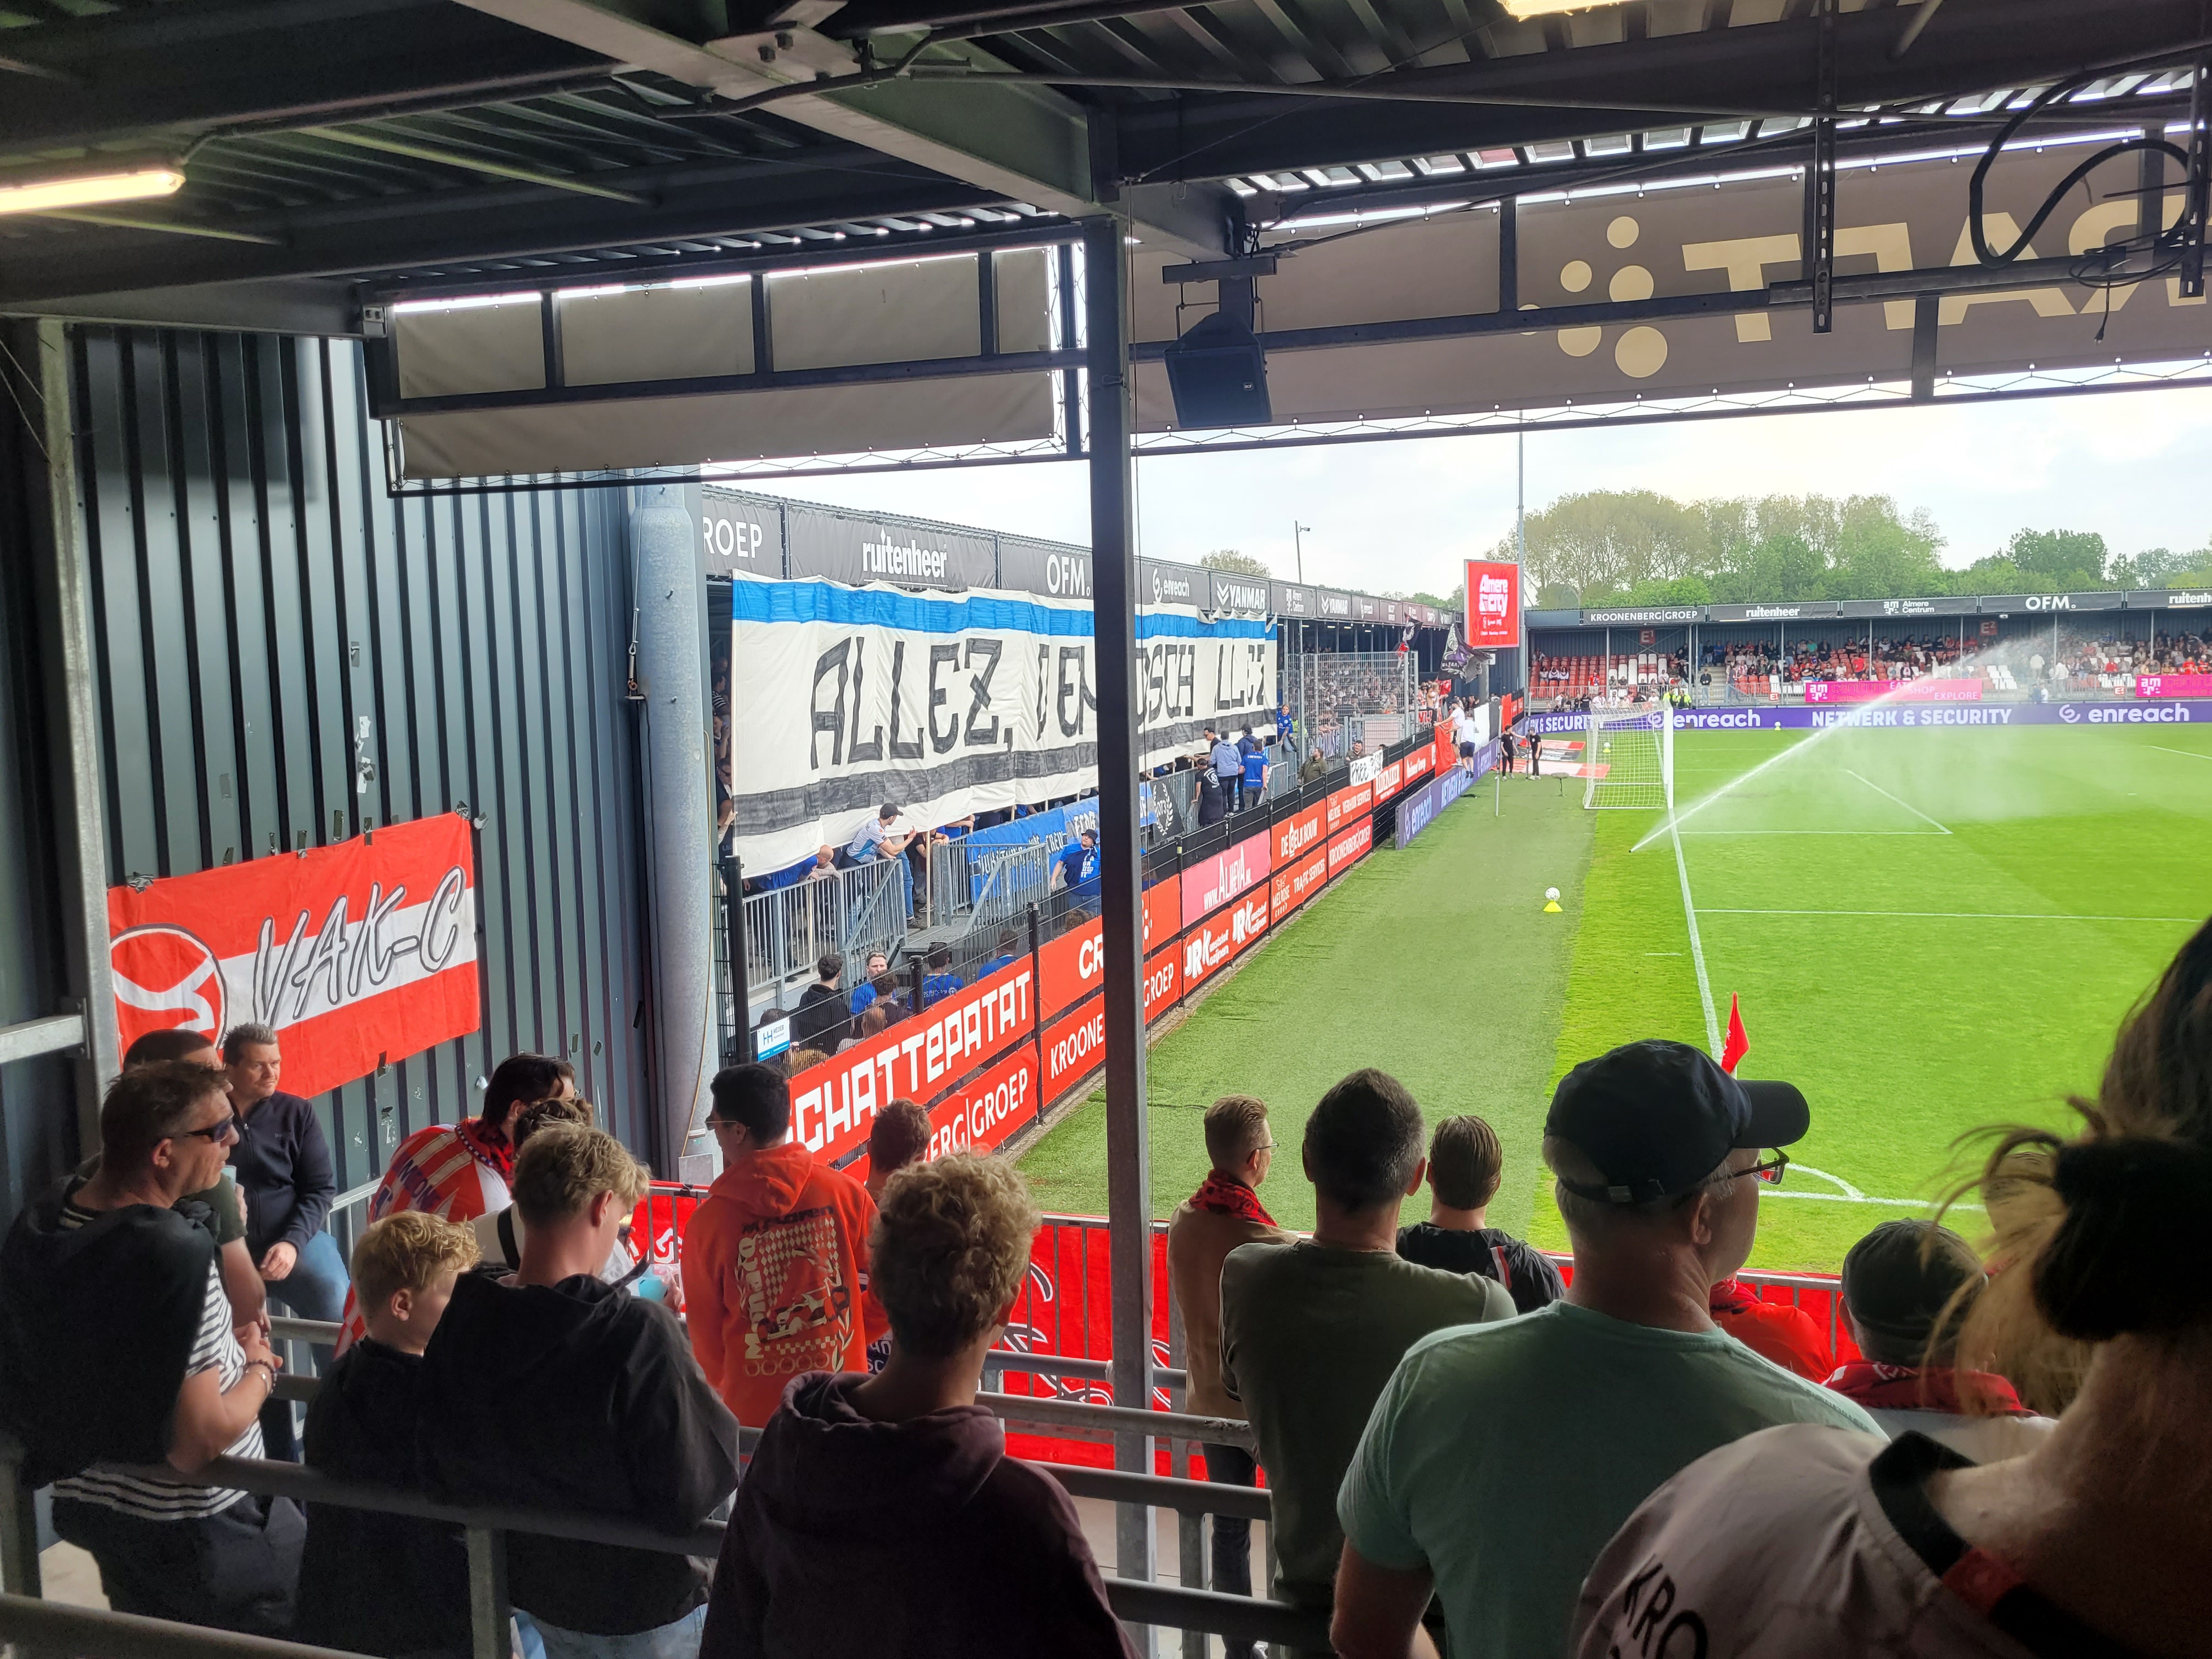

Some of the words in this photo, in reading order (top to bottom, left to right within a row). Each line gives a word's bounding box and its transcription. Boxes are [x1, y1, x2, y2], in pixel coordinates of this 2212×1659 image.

[703, 516, 763, 560] ROEP
[862, 529, 948, 578] ruitenheer
[1163, 577, 1190, 597] enreach
[1229, 584, 1266, 610] YANMAR
[2169, 591, 2212, 604] ruitenh
[1329, 597, 1348, 614] YANMAR
[1746, 606, 1800, 618] ruitenheer
[1136, 644, 1195, 724] OSCH
[1214, 644, 1265, 712] LLEZ
[1890, 681, 1906, 690] EAT
[1909, 686, 1935, 694] SHOP
[1934, 692, 1978, 700] EXPLORE
[1674, 709, 1760, 729] enreach
[1812, 709, 1898, 727] NETWERK
[1903, 710, 1915, 725] &
[1921, 708, 2012, 725] SECURITY
[2089, 703, 2190, 723] enreach
[1411, 786, 1432, 834] enreach
[1281, 836, 1289, 857] DE
[1304, 817, 1317, 843] BOUW
[1309, 858, 1325, 884] SERVICES
[1272, 884, 1290, 910] MELROSE
[1051, 1013, 1104, 1080] KROONE
[786, 970, 1030, 1153] CHATTEPATAT
[1623, 1553, 1708, 1659] KRO
